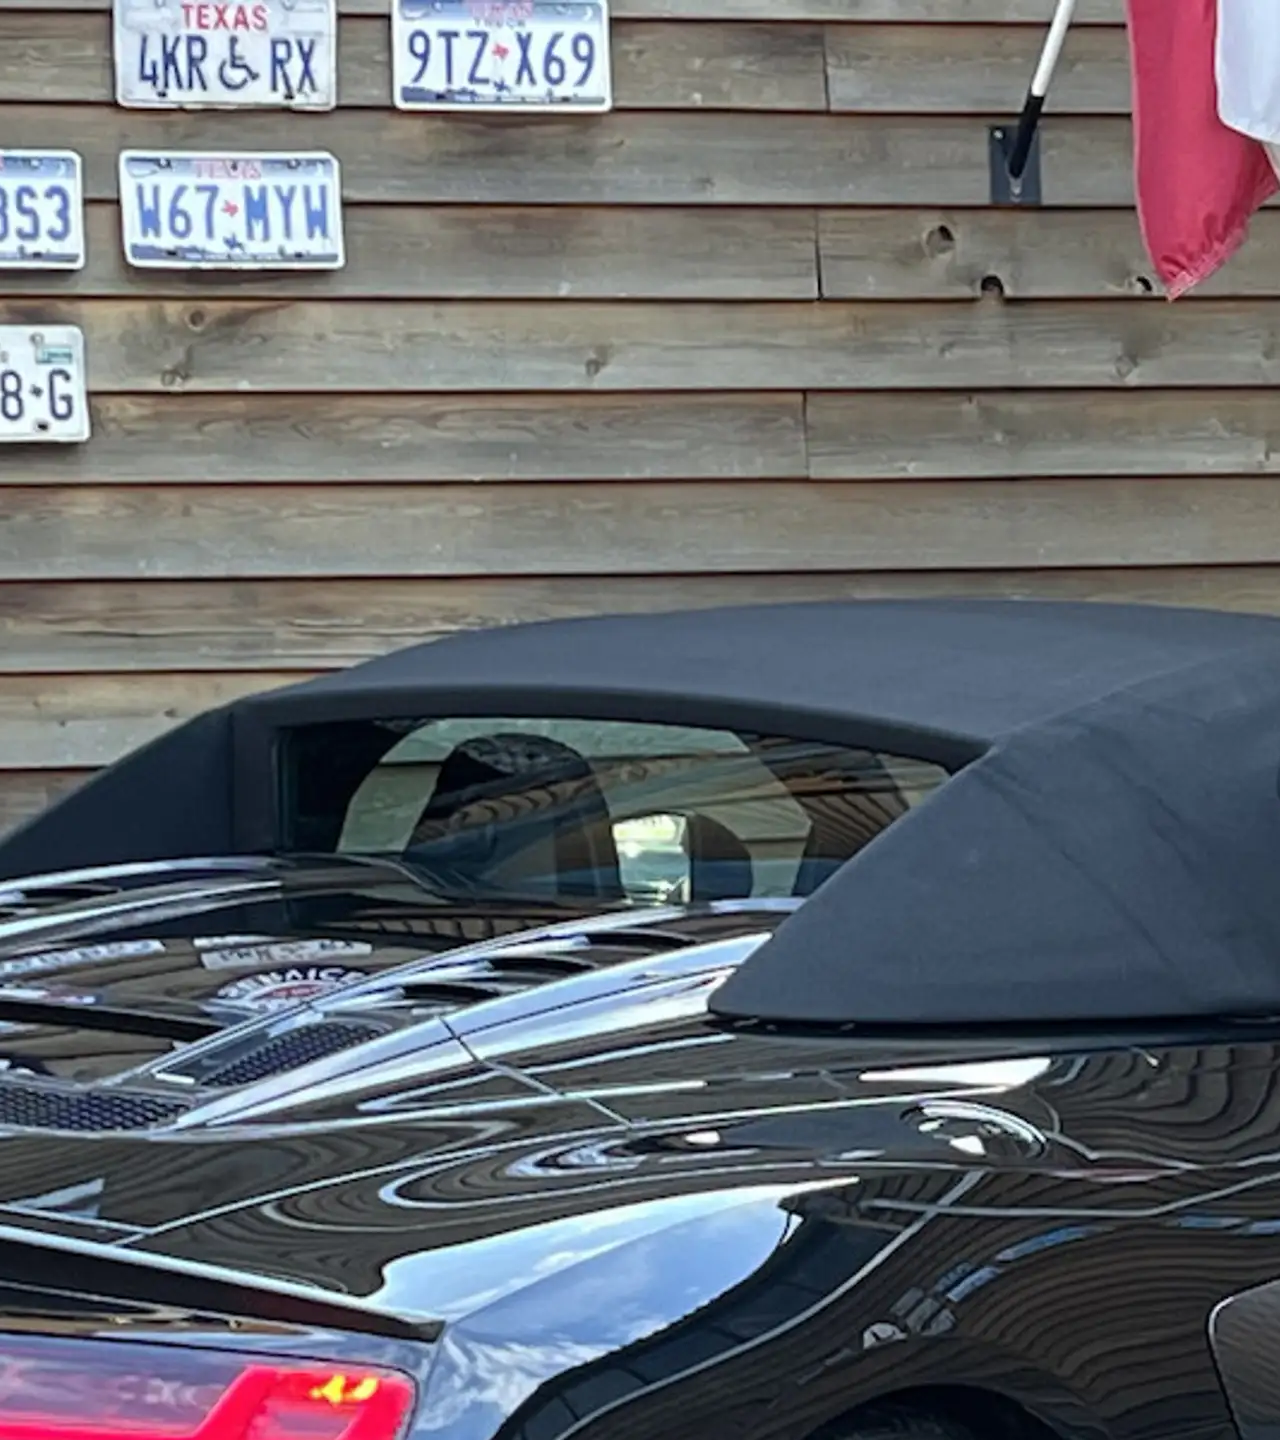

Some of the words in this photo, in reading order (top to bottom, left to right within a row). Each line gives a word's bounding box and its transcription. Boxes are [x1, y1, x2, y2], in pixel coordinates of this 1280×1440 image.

[180, 3, 268, 32] TEXAS
[138, 34, 209, 93] 4KR
[269, 38, 320, 94] RX
[406, 29, 491, 86] 9TZ
[514, 31, 596, 88] X69
[136, 184, 220, 240] W67
[242, 184, 329, 243] MYW
